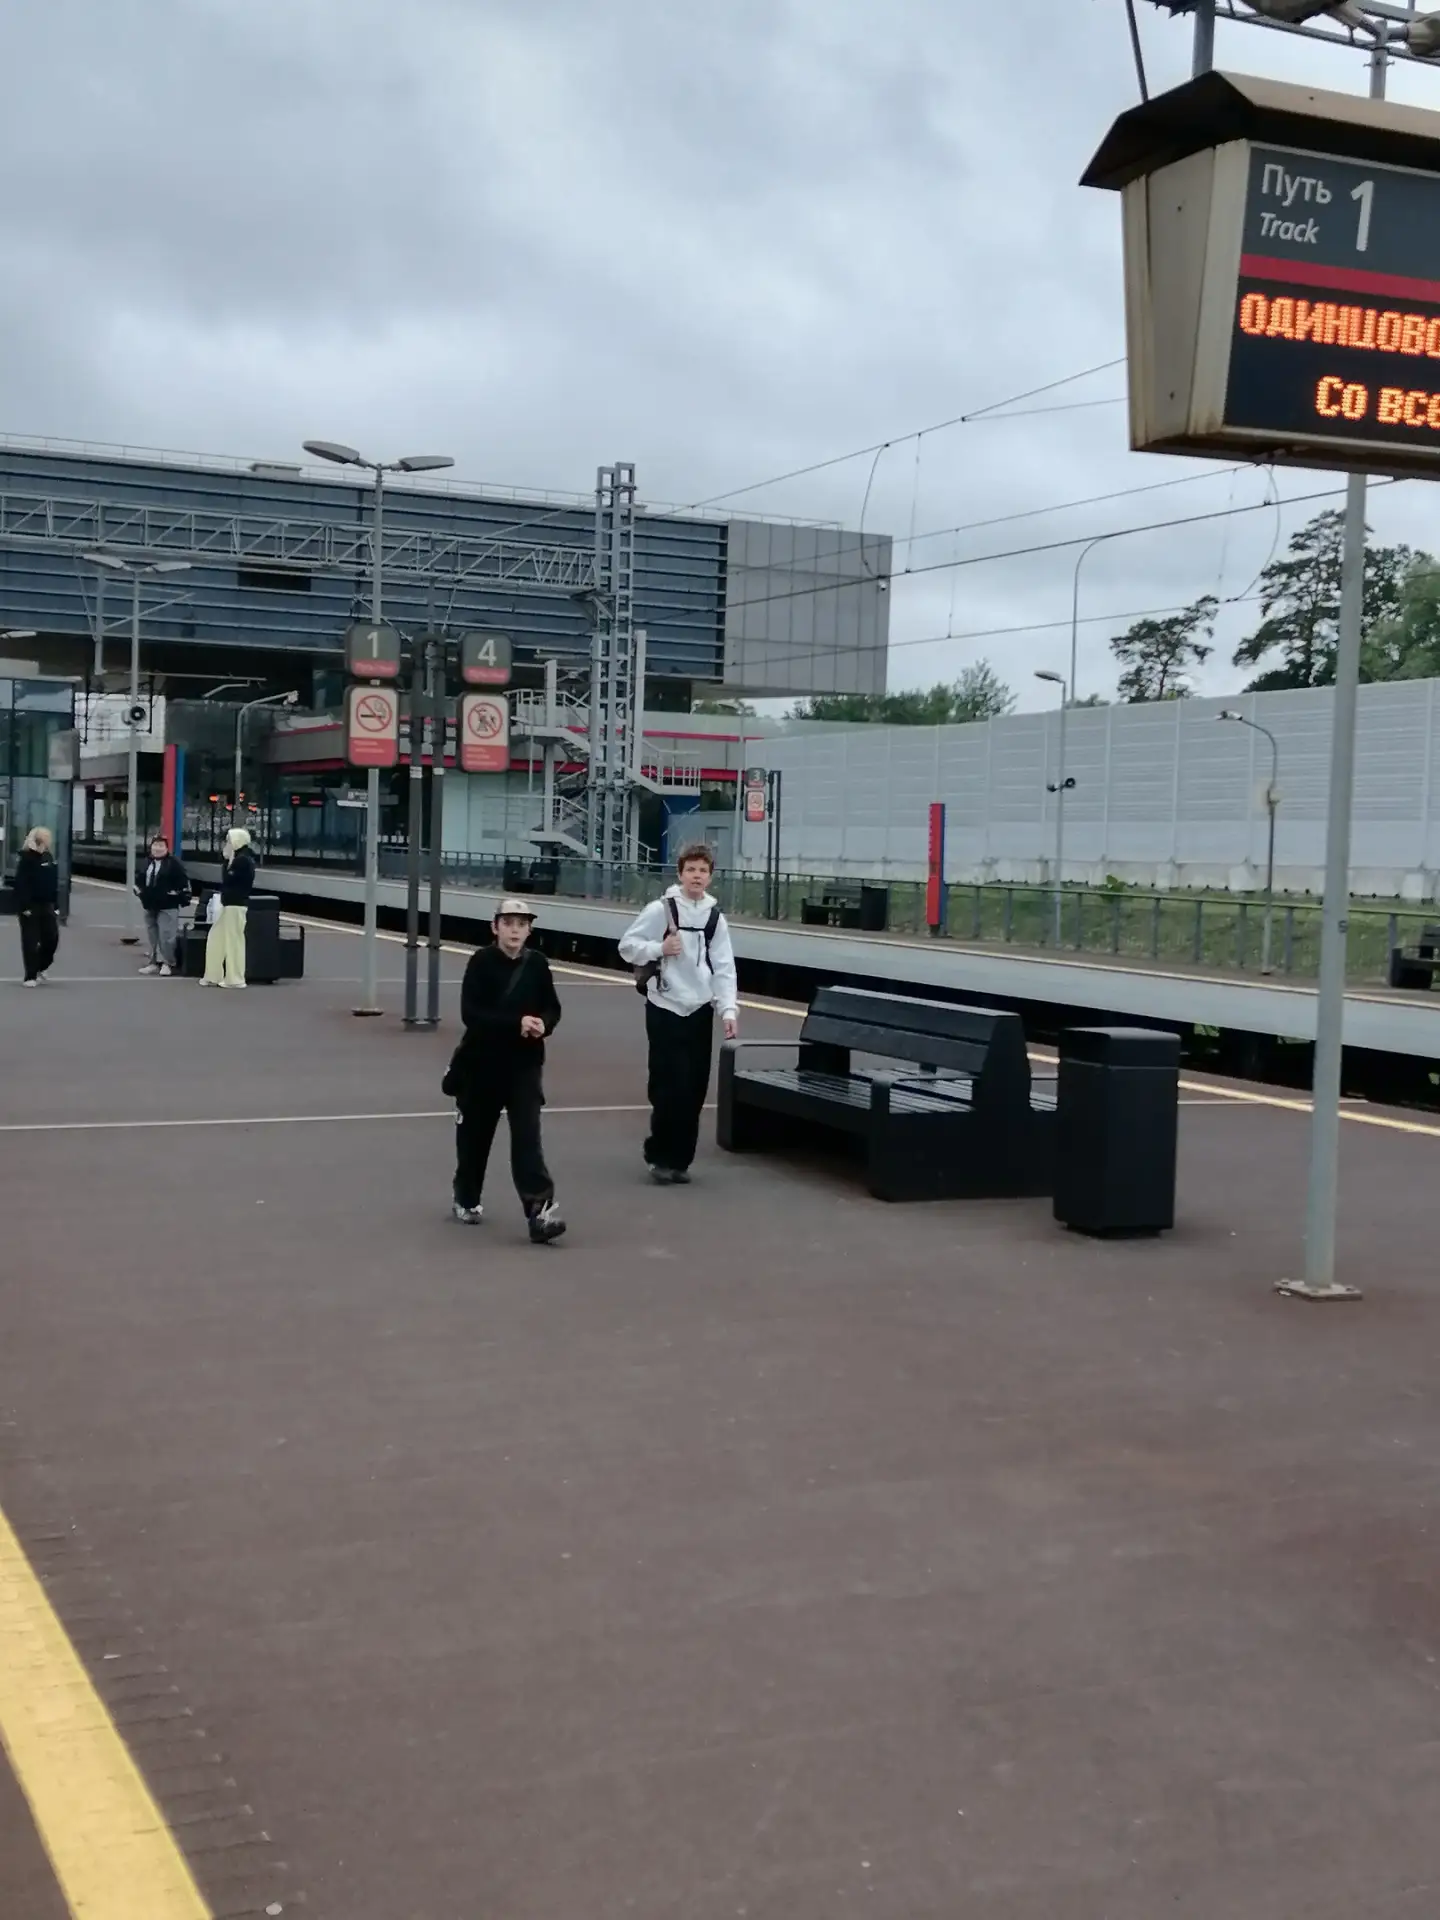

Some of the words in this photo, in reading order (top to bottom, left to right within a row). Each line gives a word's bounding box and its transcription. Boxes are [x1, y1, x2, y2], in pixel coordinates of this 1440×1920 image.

[1261, 163, 1333, 207] Путь
[1350, 180, 1375, 252] 1
[1260, 212, 1321, 244] Track
[1314, 376, 1368, 421] Со
[366, 631, 379, 659] 1
[477, 639, 498, 667] 4
[752, 770, 761, 781] 3
